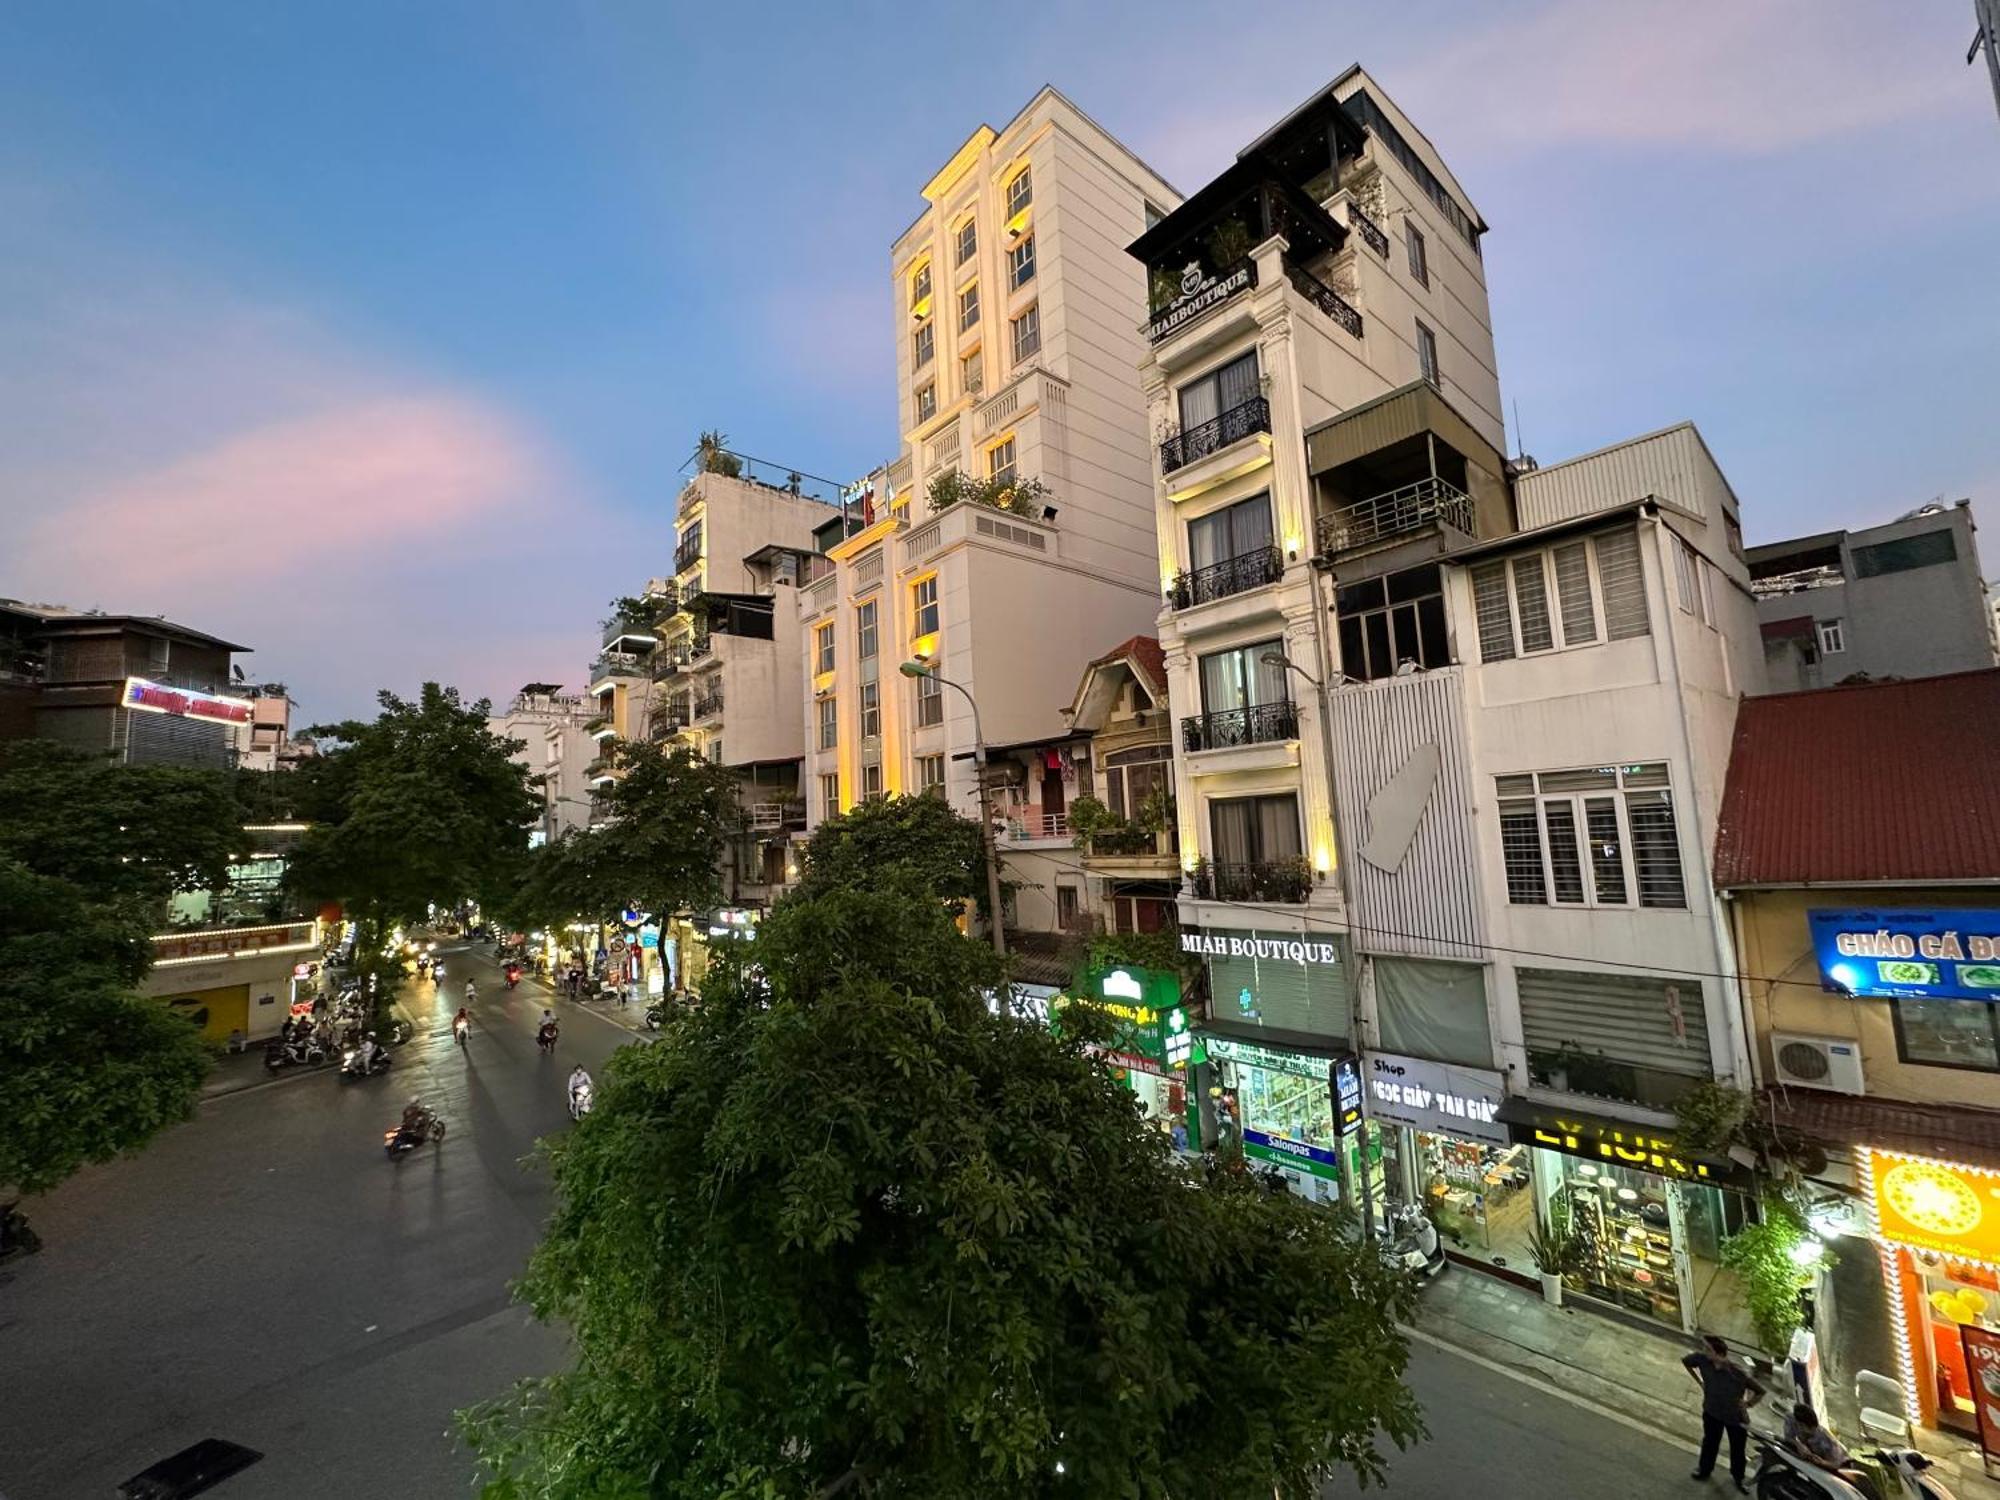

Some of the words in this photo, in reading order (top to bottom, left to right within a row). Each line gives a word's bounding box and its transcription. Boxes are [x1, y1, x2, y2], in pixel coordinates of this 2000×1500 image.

[1181, 934, 1227, 955] MIAH
[1231, 938, 1335, 966] BOUTIQUE
[1836, 929, 1915, 958] CHÁO
[1919, 931, 1965, 960] CÁ
[1374, 1059, 1405, 1077] Shop
[1268, 1136, 1311, 1156] Salonpas
